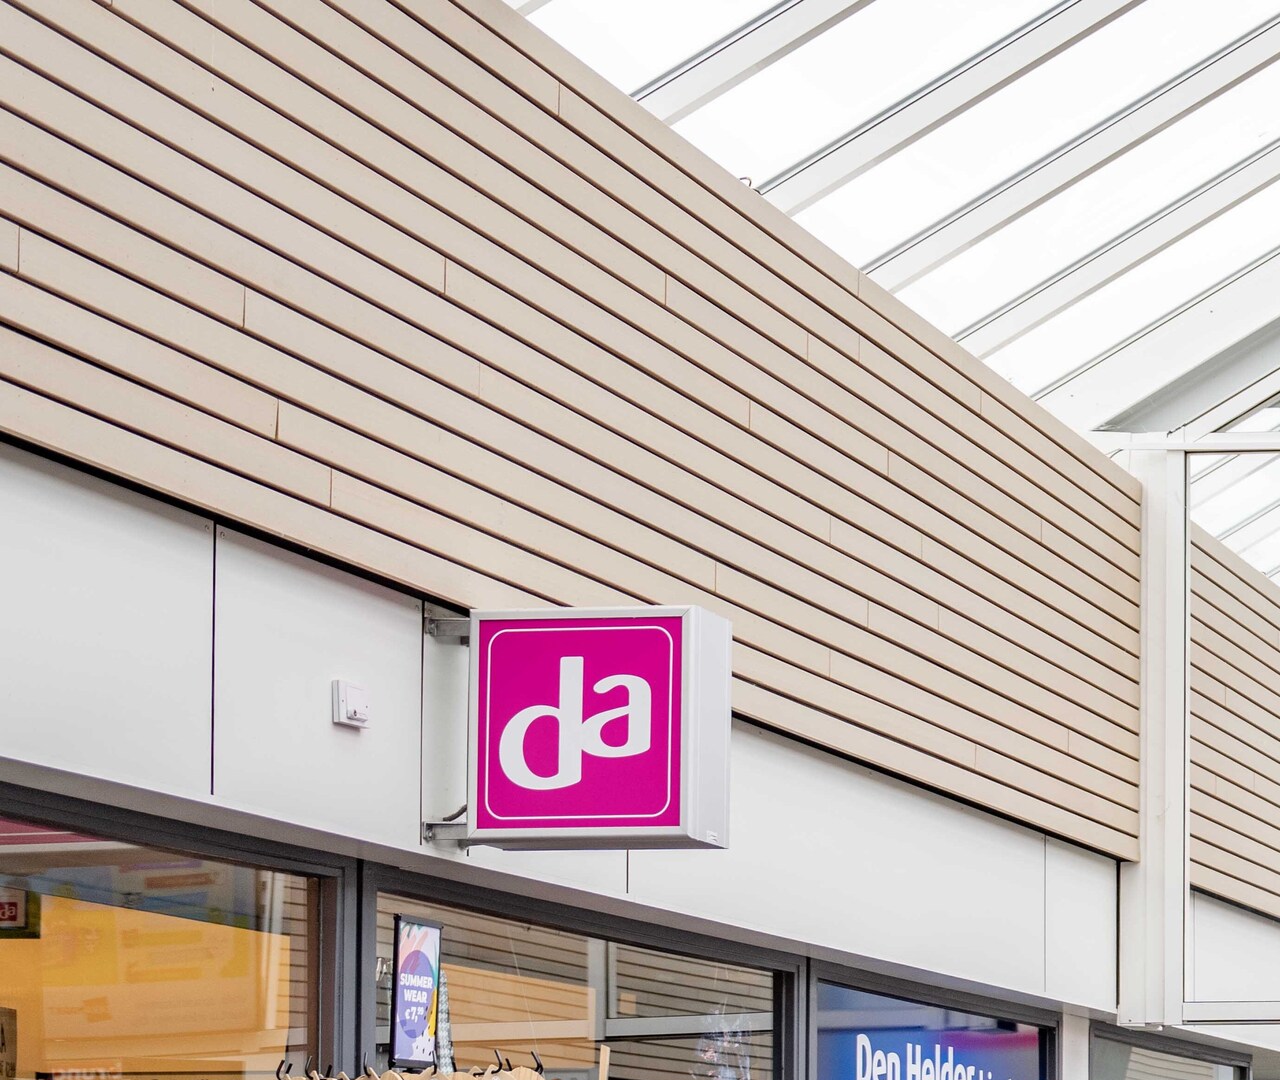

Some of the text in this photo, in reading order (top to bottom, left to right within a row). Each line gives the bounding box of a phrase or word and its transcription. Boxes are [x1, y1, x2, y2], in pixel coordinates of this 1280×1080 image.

[499, 656, 652, 790] da
[400, 973, 433, 989] SUMMER
[404, 989, 428, 1003] WEAR
